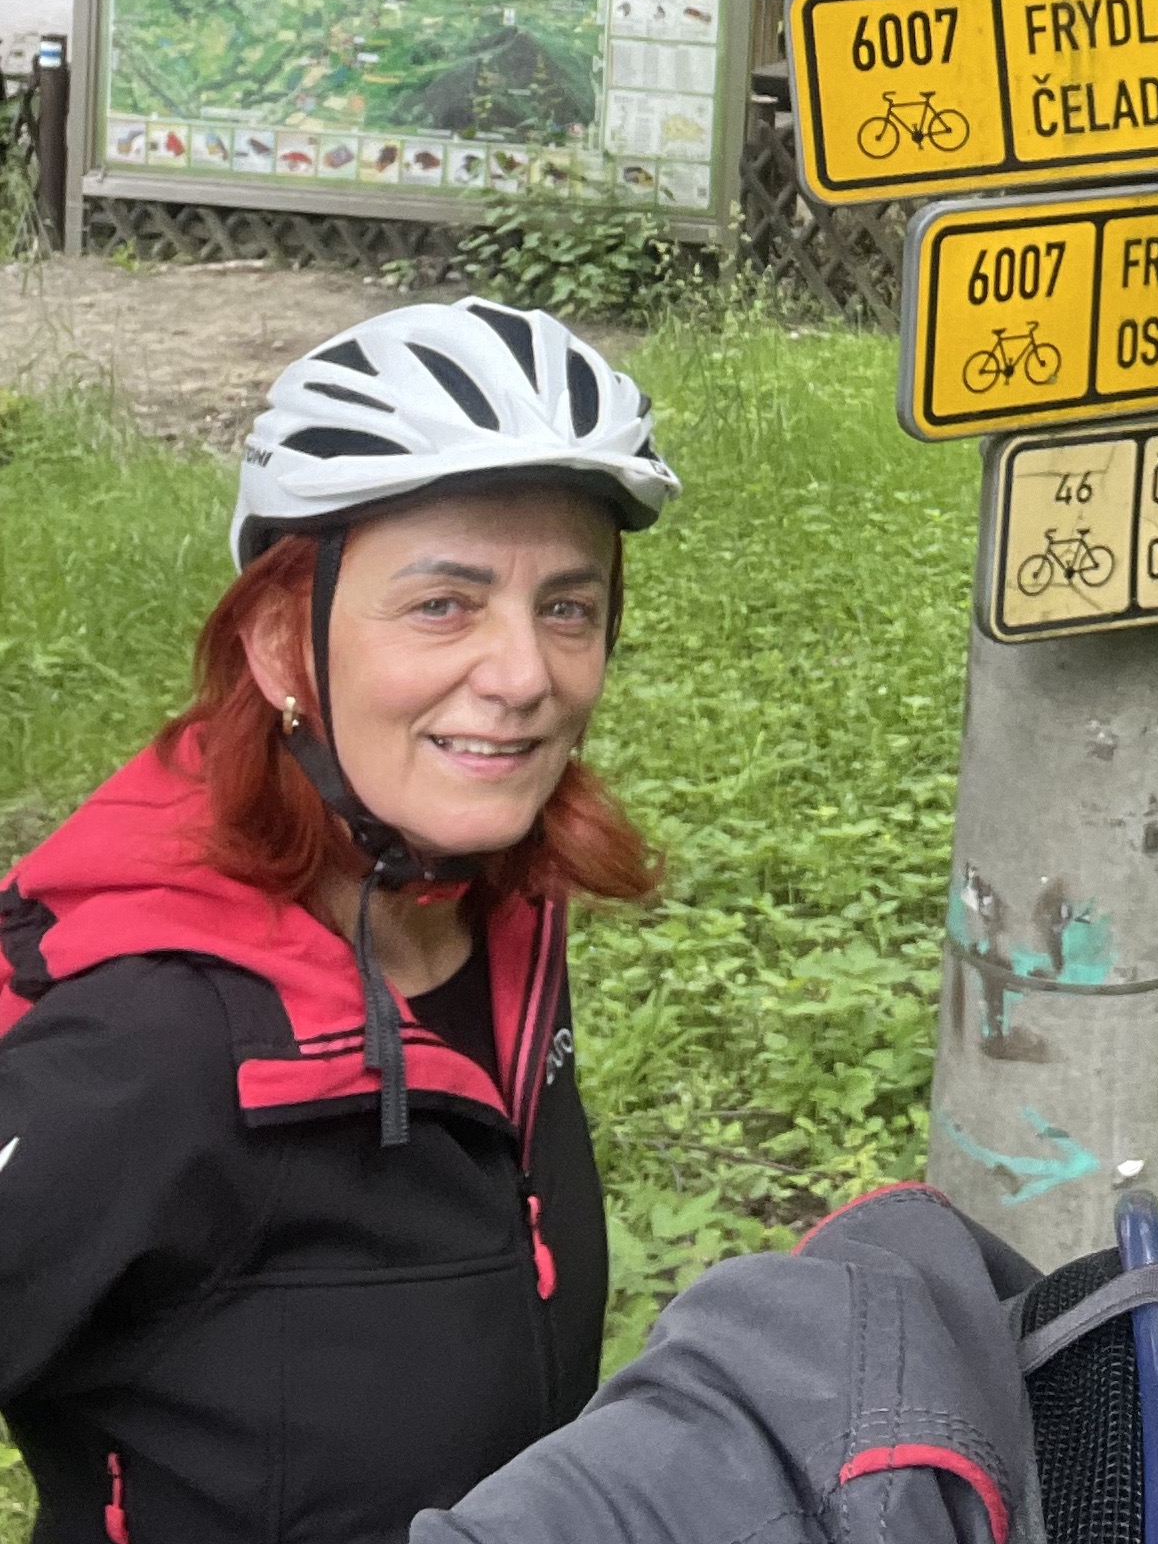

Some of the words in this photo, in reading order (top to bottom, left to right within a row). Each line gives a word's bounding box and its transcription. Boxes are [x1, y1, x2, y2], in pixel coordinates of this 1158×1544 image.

[851, 5, 960, 72] 6007
[967, 240, 1068, 306] 6007
[1054, 471, 1093, 504] 46
